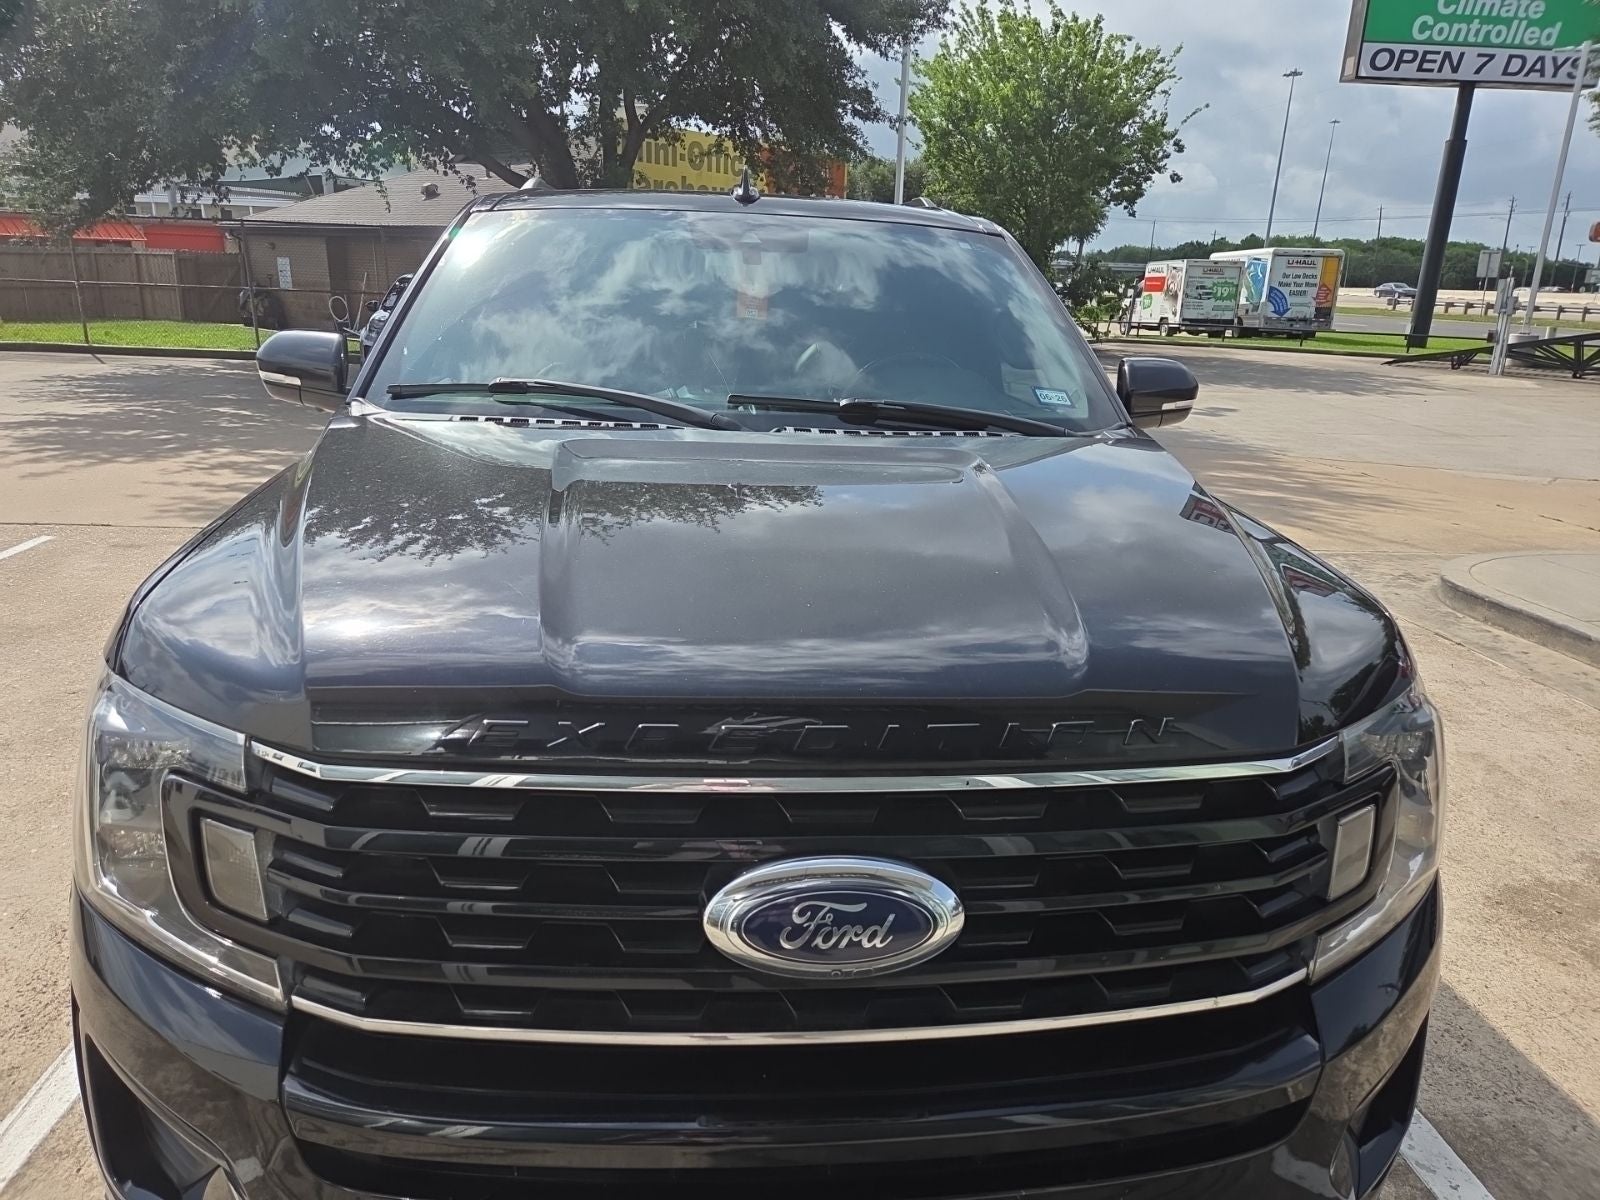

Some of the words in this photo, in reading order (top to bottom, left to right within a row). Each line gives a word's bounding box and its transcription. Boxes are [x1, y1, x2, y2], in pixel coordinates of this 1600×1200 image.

[1437, 0, 1546, 18] Climate
[1411, 15, 1562, 46] Controlled
[1369, 47, 1465, 74] OPEN
[1473, 53, 1496, 75] 7
[467, 716, 1176, 752] EXPEDITION
[780, 901, 896, 949] Ford
